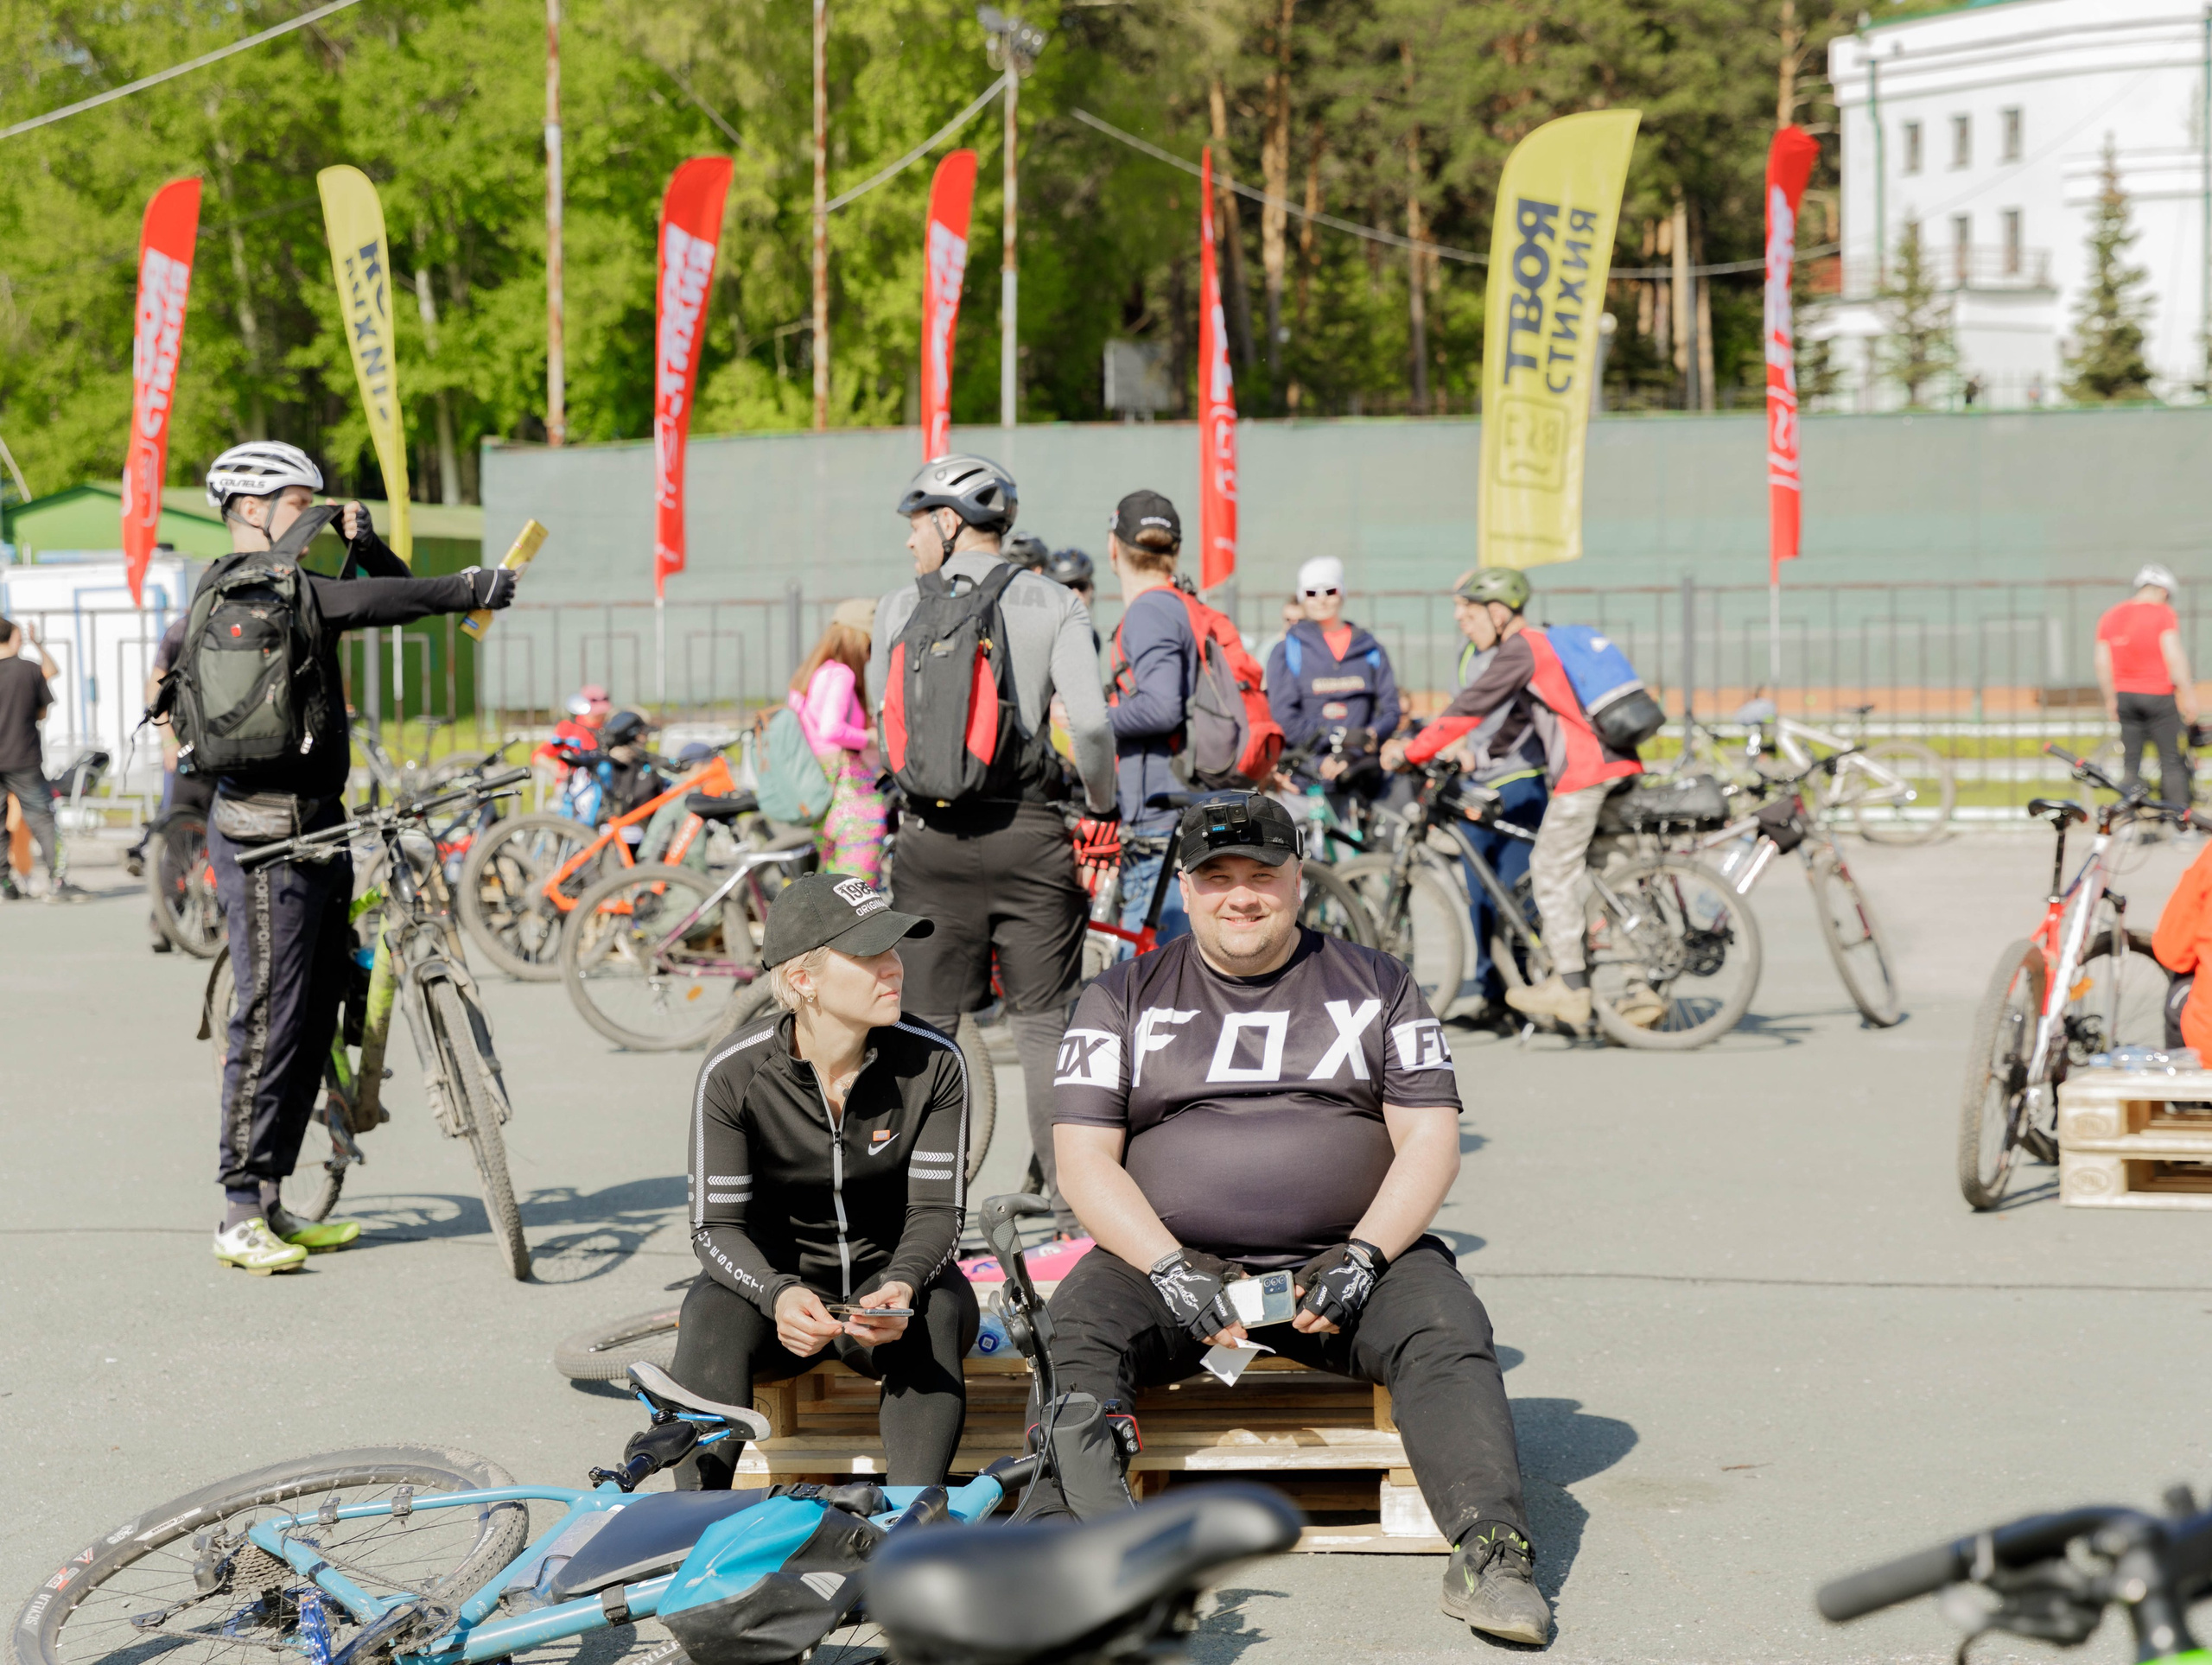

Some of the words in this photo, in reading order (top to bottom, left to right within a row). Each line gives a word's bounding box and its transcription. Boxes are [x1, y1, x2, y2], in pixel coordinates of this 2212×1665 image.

[1503, 198, 1560, 385] ТВОЯ
[1545, 207, 1597, 394] СТИХИЯ
[1055, 1034, 1110, 1079] OX
[1132, 999, 1382, 1088] FOX
[1213, 1293, 1229, 1317] MOREO
[24, 1592, 53, 1626] SCYLLA
